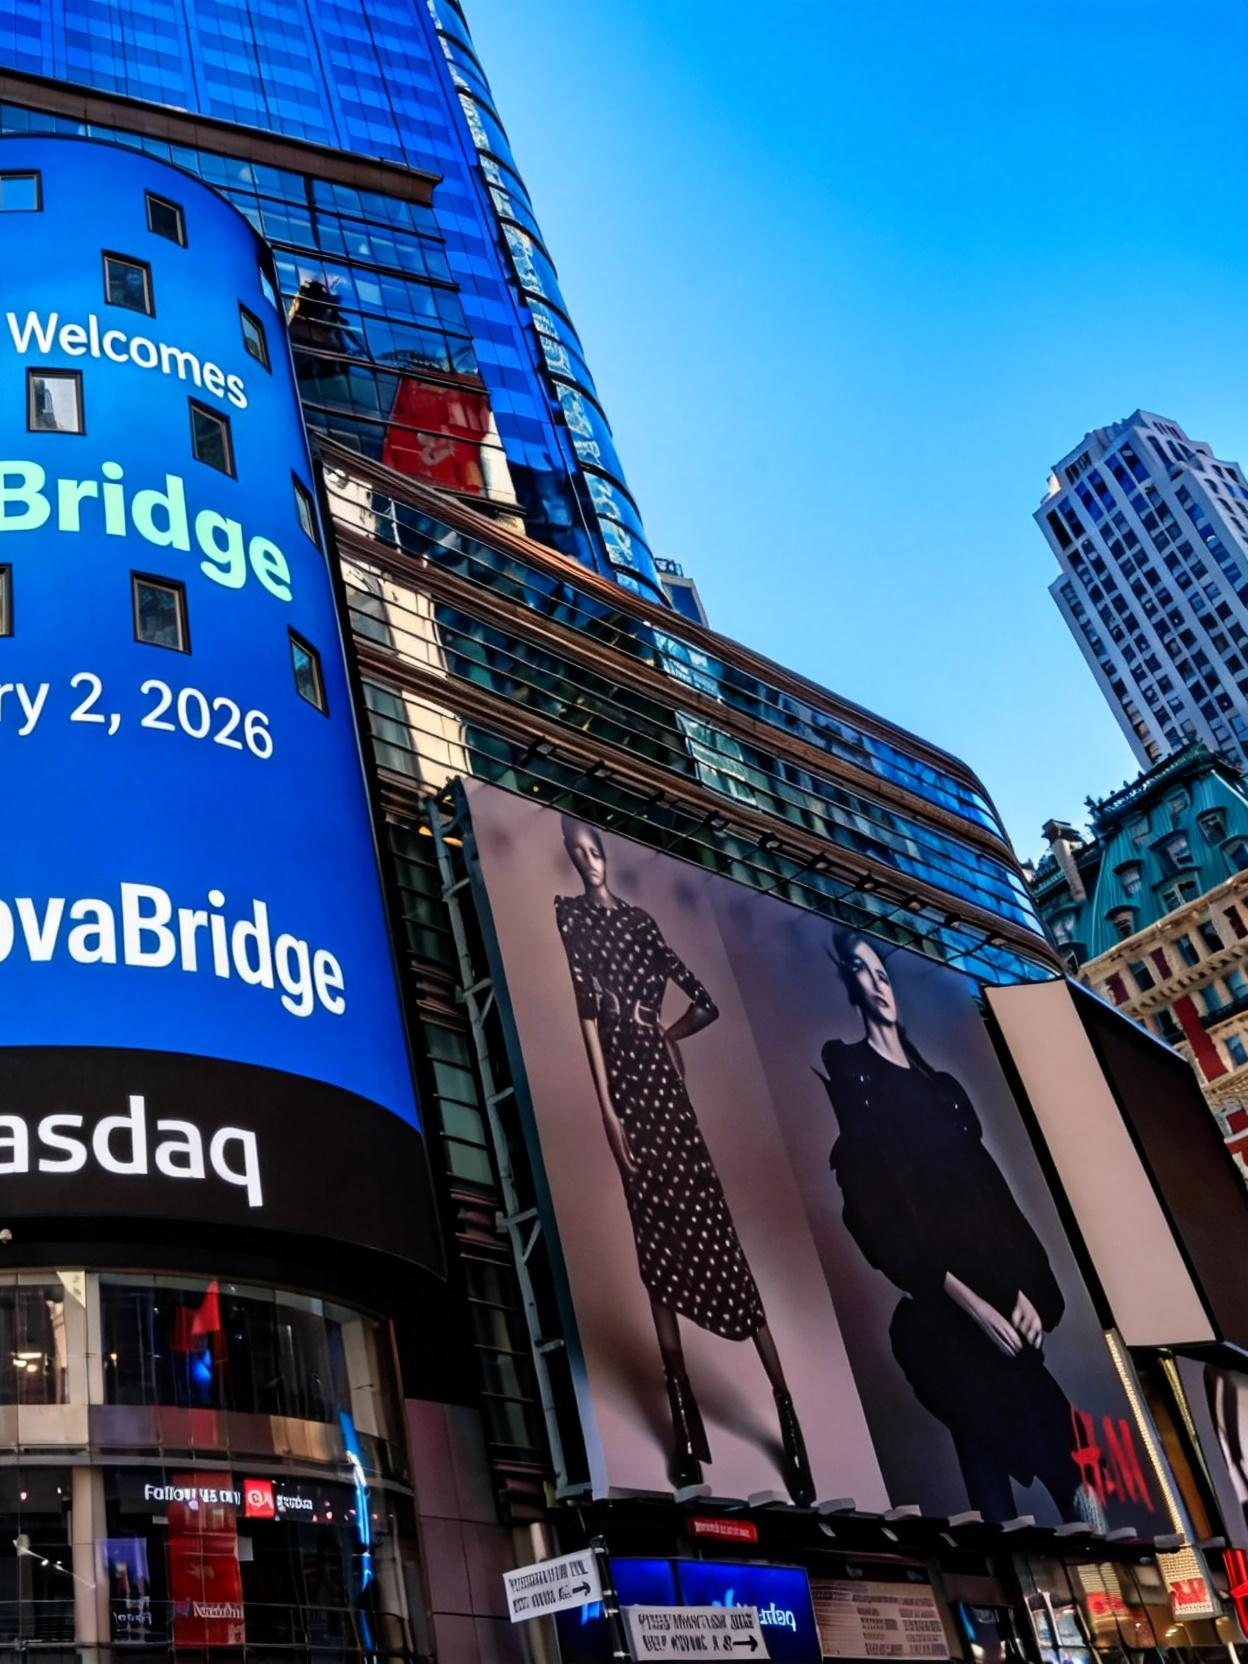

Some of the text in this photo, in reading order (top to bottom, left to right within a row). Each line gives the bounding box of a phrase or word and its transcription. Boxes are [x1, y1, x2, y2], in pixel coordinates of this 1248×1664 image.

[6, 311, 248, 409] Welcomes
[70, 671, 121, 736] 2,
[141, 679, 273, 759] 2026
